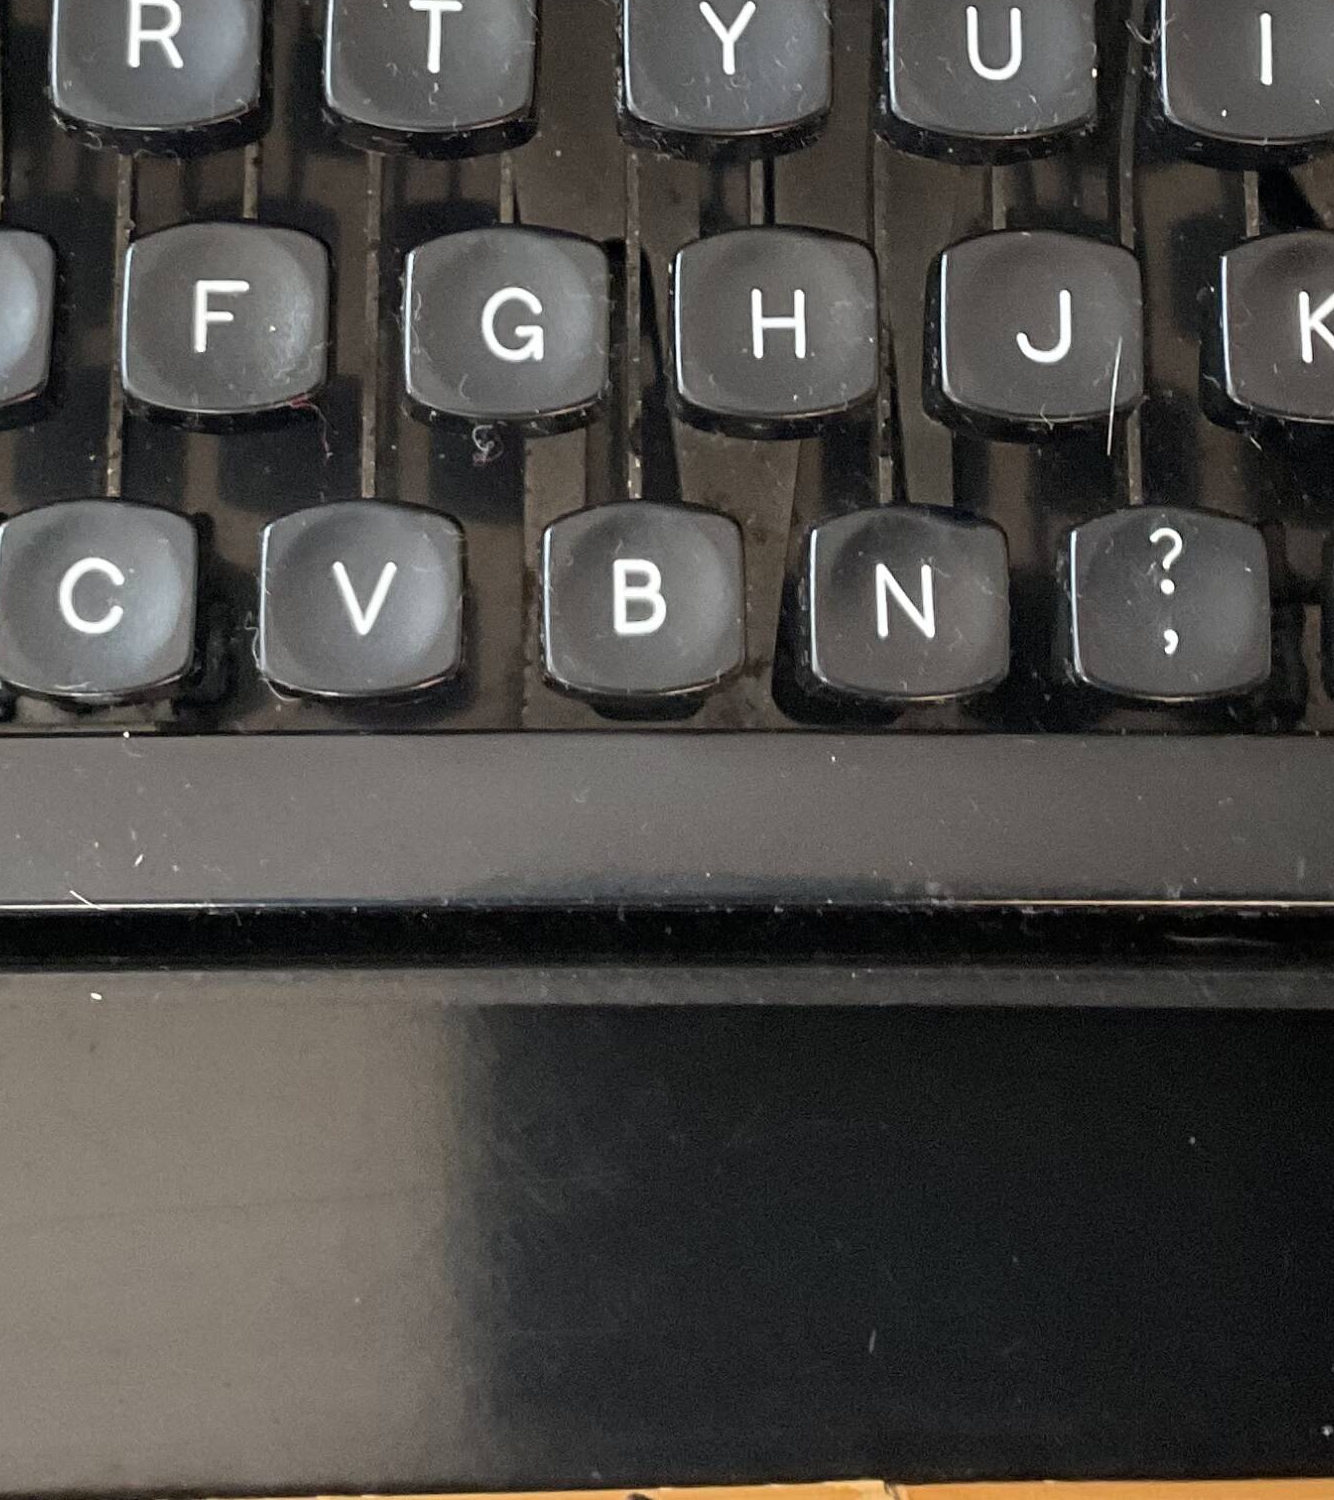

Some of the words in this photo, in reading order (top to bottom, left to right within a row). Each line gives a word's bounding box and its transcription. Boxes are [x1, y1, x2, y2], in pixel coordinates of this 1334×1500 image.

[699, 0, 756, 75] Y
[966, 6, 1022, 81] U
[194, 280, 250, 353] F
[481, 287, 544, 362] G
[751, 288, 806, 359] H
[1016, 289, 1072, 363] J
[59, 557, 125, 634] C
[332, 561, 398, 636] V
[613, 558, 667, 635] B
[1149, 527, 1183, 595] ?
[875, 563, 936, 639] N
